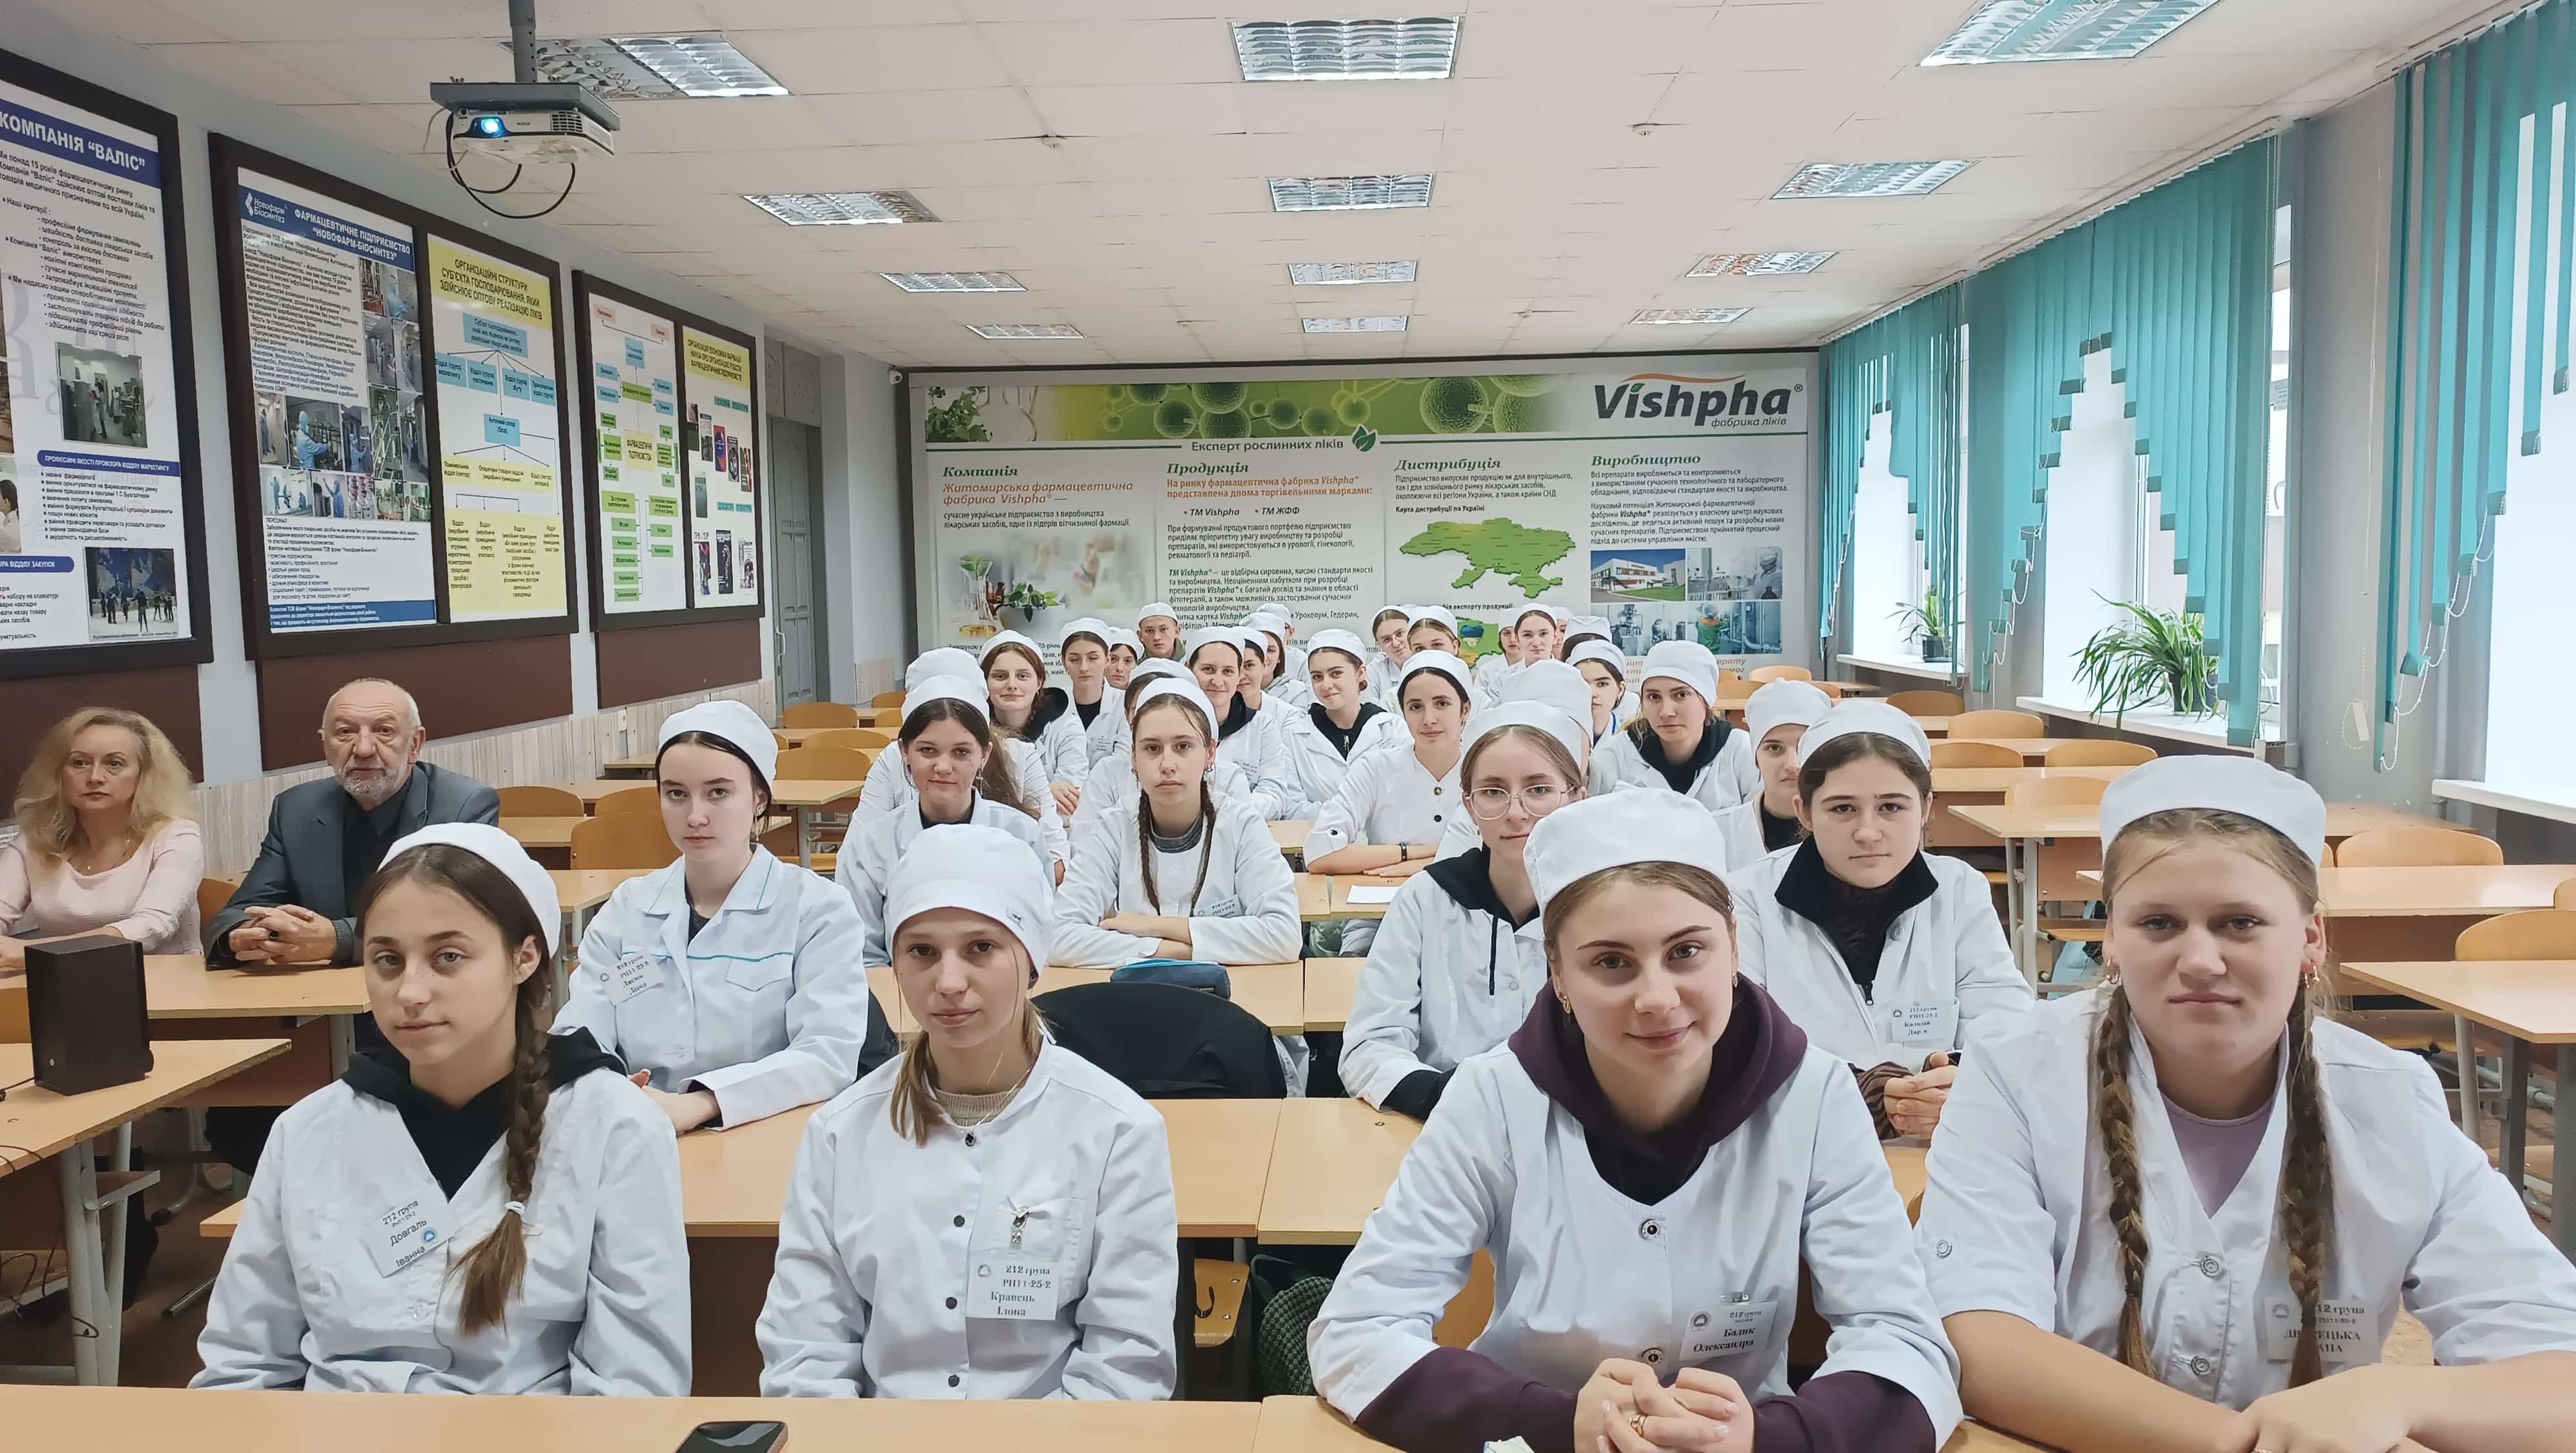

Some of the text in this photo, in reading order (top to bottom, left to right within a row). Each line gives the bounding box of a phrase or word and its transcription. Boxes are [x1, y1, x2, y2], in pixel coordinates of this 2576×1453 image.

[0, 111, 84, 154] КОМПАНІЯ
[9, 154, 30, 167] понад
[31, 160, 38, 169] 15
[294, 209, 411, 254] ФАРМАЦЕВТИЧНЕ ПІДПРИЄМСТВО
[455, 259, 528, 292] ОРГАНІЗАЦІЙНІ СТРУКТУРИ
[439, 279, 472, 298] ЗДІЙСНЮЄ
[473, 290, 496, 305] ОПТОВУ
[1711, 417, 1786, 428] фабрика ліків
[1191, 439, 1343, 452] Експерт рослинних ліків
[1394, 457, 1500, 472] Дистрибуція
[1590, 455, 1701, 467] Виробництво
[943, 466, 1018, 477] Компанія
[1166, 462, 1248, 476] Продукція
[943, 482, 1133, 494] Житомирська фармацевтична
[1208, 477, 1279, 488] фармацевтична
[1281, 476, 1320, 487] фабрика
[943, 494, 996, 506] фабрика
[1205, 507, 1240, 517] Vishpha
[1196, 614, 1218, 622] картка
[382, 1212, 397, 1225] 212
[398, 1200, 419, 1217] група
[390, 1220, 427, 1246] Довгаль
[396, 1246, 425, 1267] Іванна
[1006, 1265, 1050, 1276] 212 група
[2317, 1304, 2365, 1316] 12 група
[1693, 1340, 1754, 1352] Олександра
